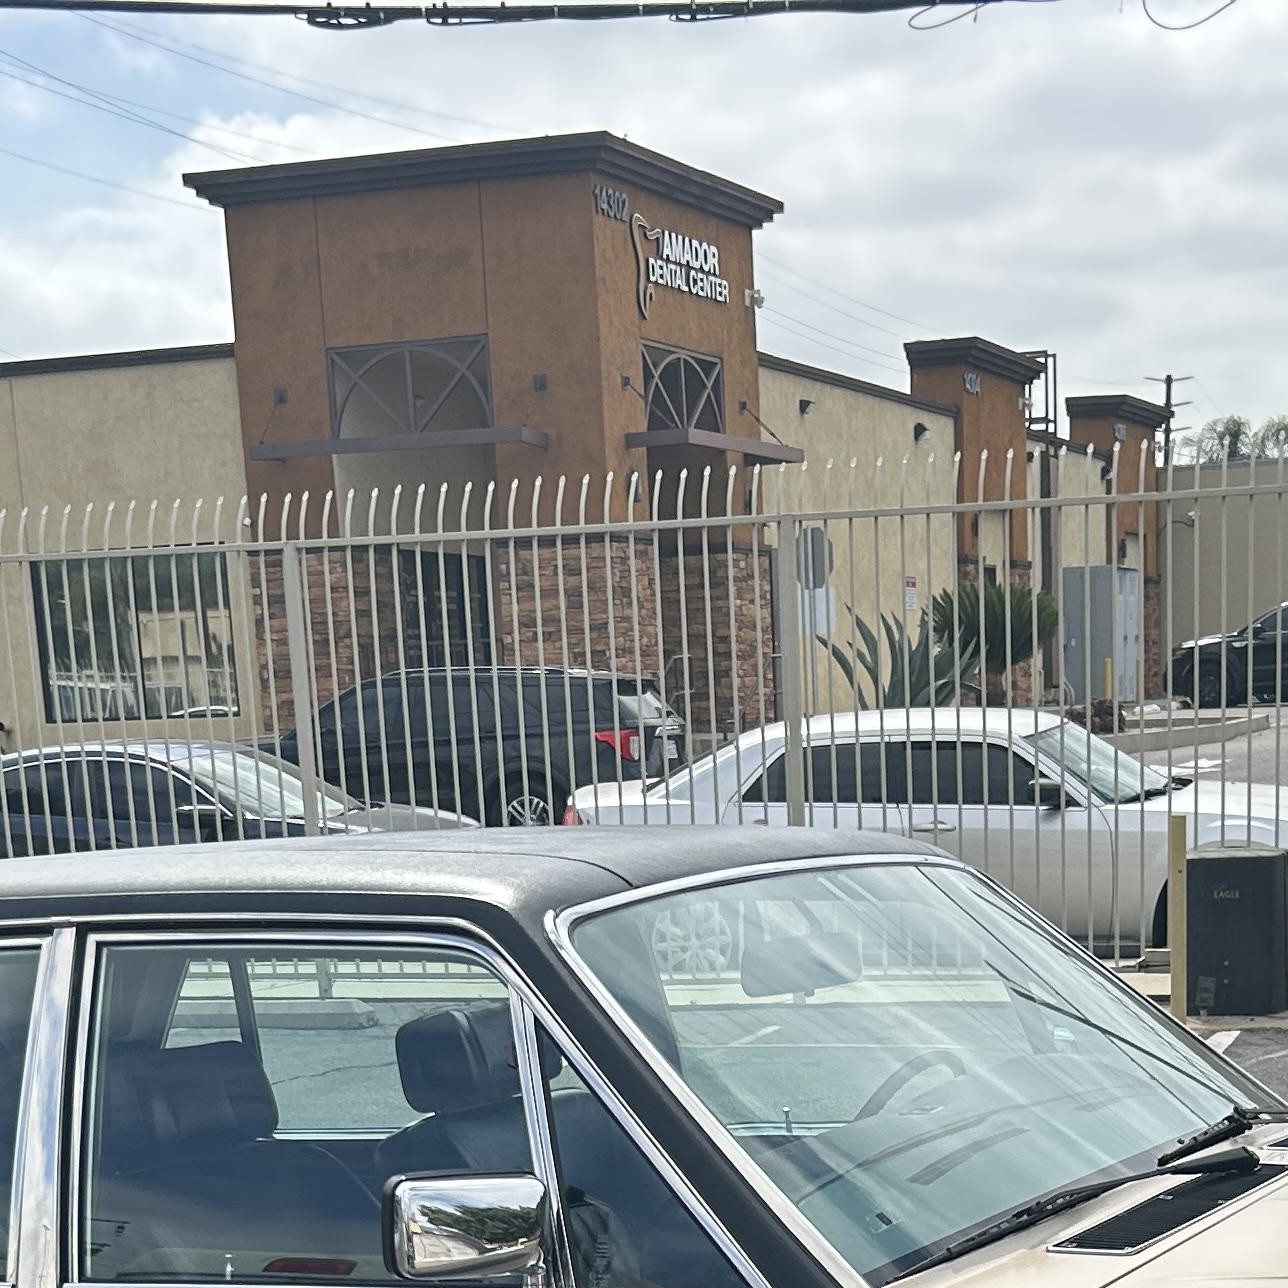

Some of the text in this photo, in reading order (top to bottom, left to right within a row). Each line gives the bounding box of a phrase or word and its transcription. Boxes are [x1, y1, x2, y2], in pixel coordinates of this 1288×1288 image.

[594, 184, 629, 222] 14302
[663, 230, 720, 275] AMADOR
[648, 257, 730, 303] DENTAL CENTER
